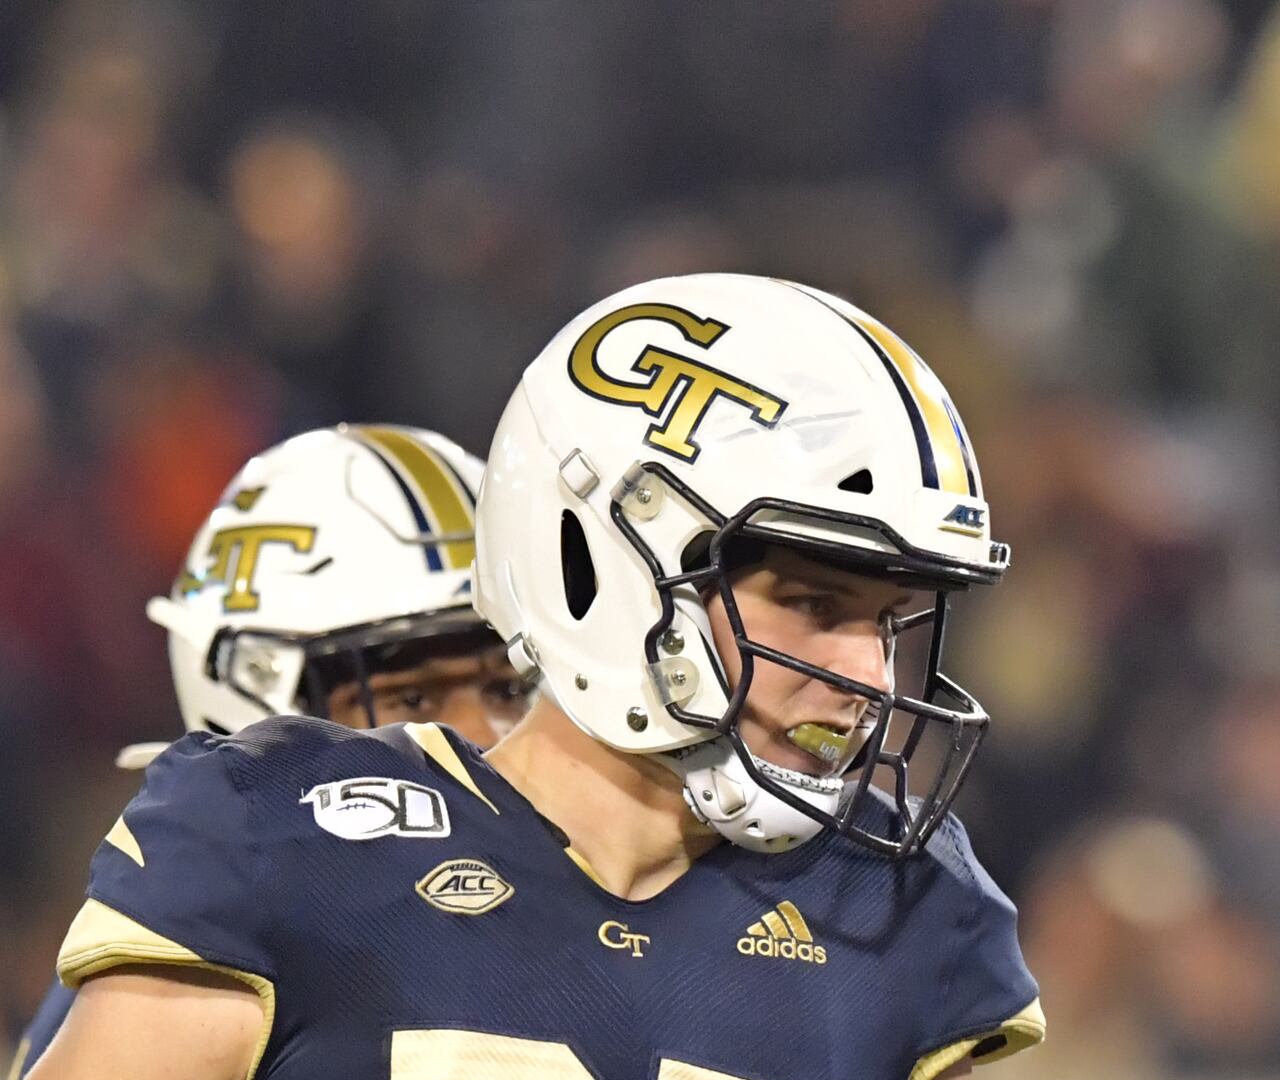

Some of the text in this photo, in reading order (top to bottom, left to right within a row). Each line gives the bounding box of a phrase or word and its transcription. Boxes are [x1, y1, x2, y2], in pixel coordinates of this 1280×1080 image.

[567, 302, 788, 464] GT
[316, 776, 445, 835] 150
[435, 874, 497, 893] ACC
[598, 920, 651, 958] GT
[736, 934, 827, 964] adidas
